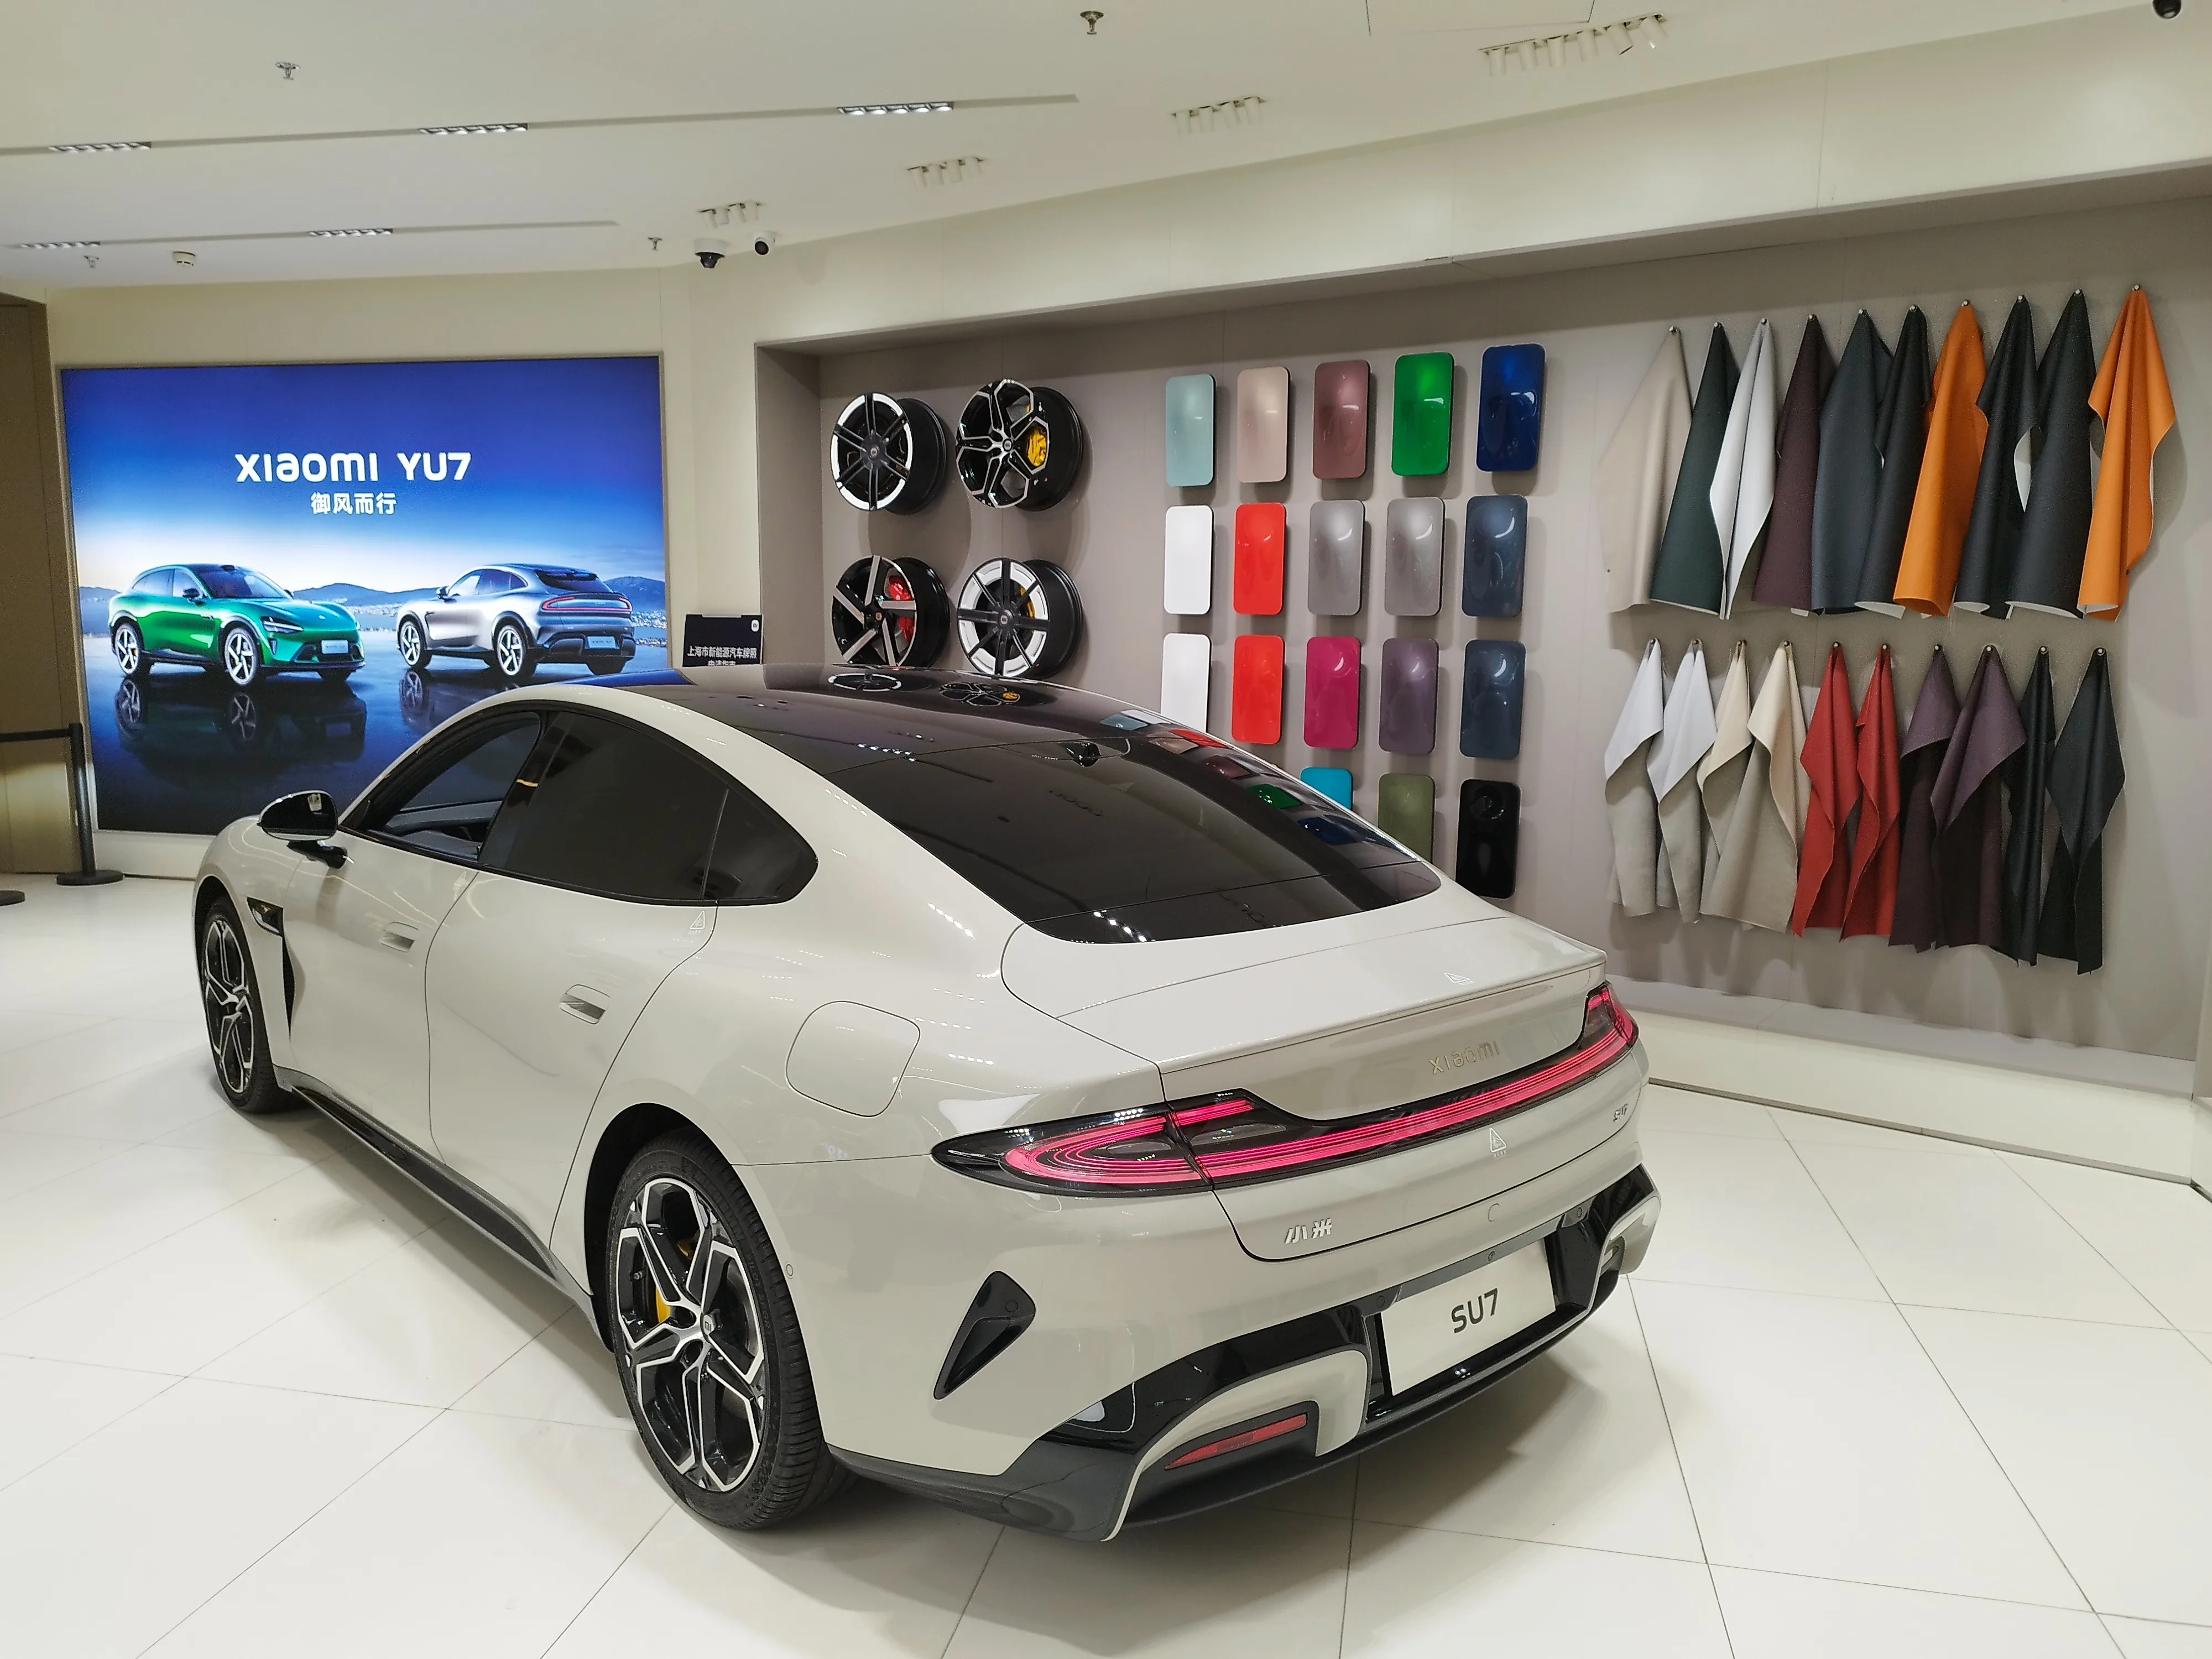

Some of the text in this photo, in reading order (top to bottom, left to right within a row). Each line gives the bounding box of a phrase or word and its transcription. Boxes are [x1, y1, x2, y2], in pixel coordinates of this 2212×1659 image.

[397, 452, 472, 481] YU7
[311, 492, 397, 515] 御风而行
[687, 645, 757, 659] 上海市新能源汽车牌照
[1284, 1218, 1332, 1244] 小米
[1451, 1288, 1498, 1333] SU7
